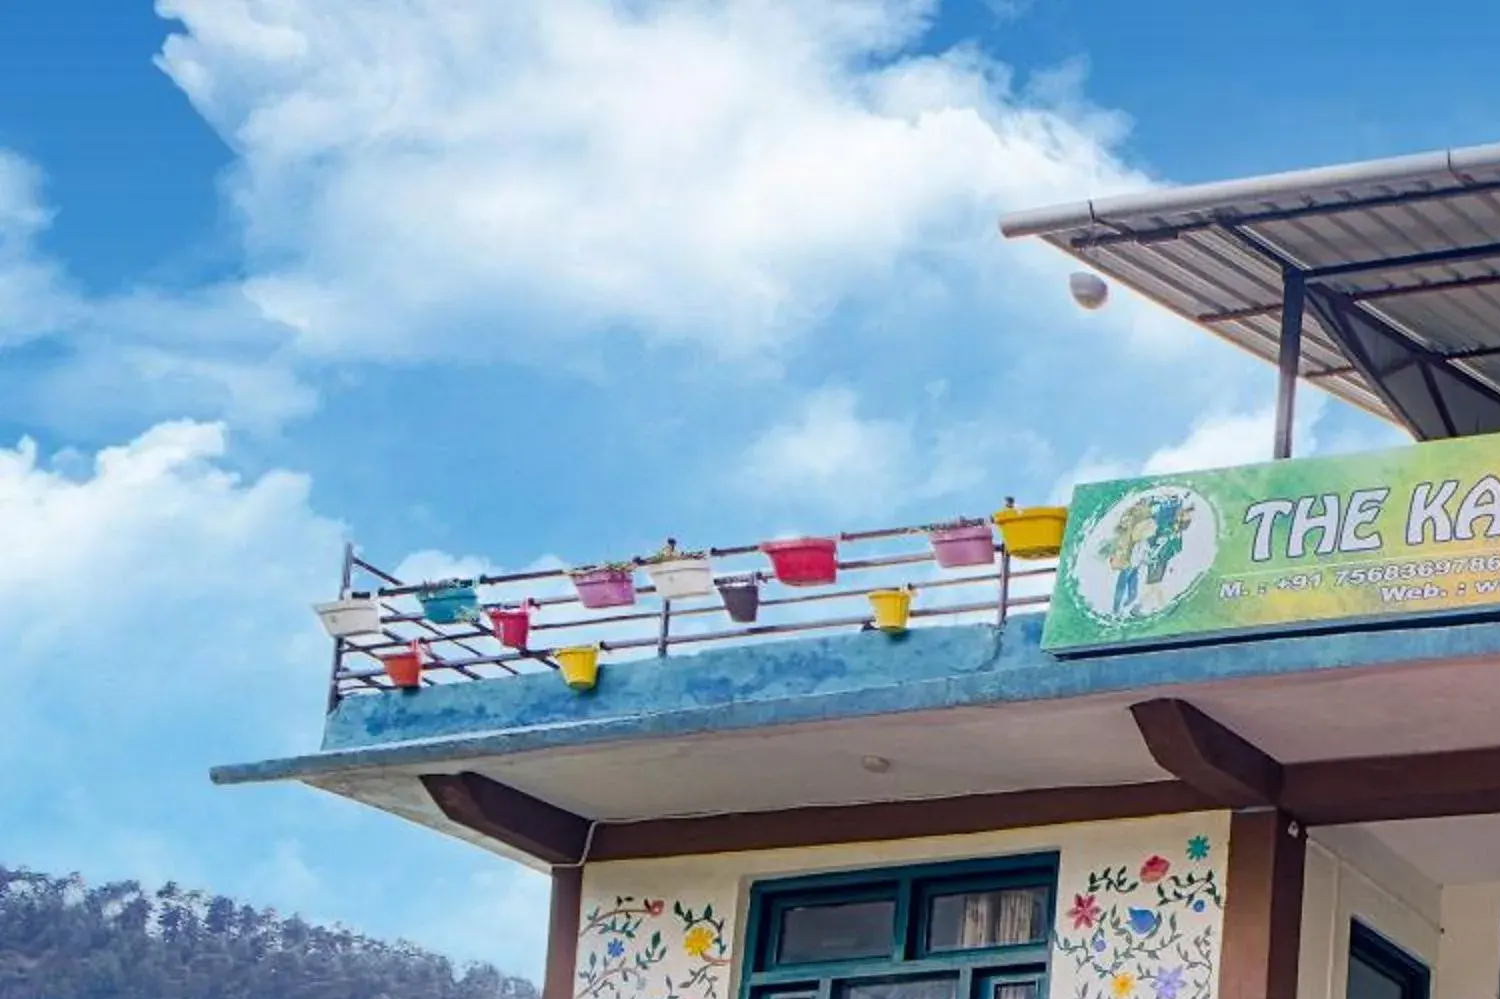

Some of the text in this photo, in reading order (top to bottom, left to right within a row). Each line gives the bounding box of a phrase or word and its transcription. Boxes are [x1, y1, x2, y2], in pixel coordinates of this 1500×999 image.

[1243, 487, 1391, 562] THE
[1276, 572, 1323, 592] +91
[1381, 580, 1448, 602] Web.
